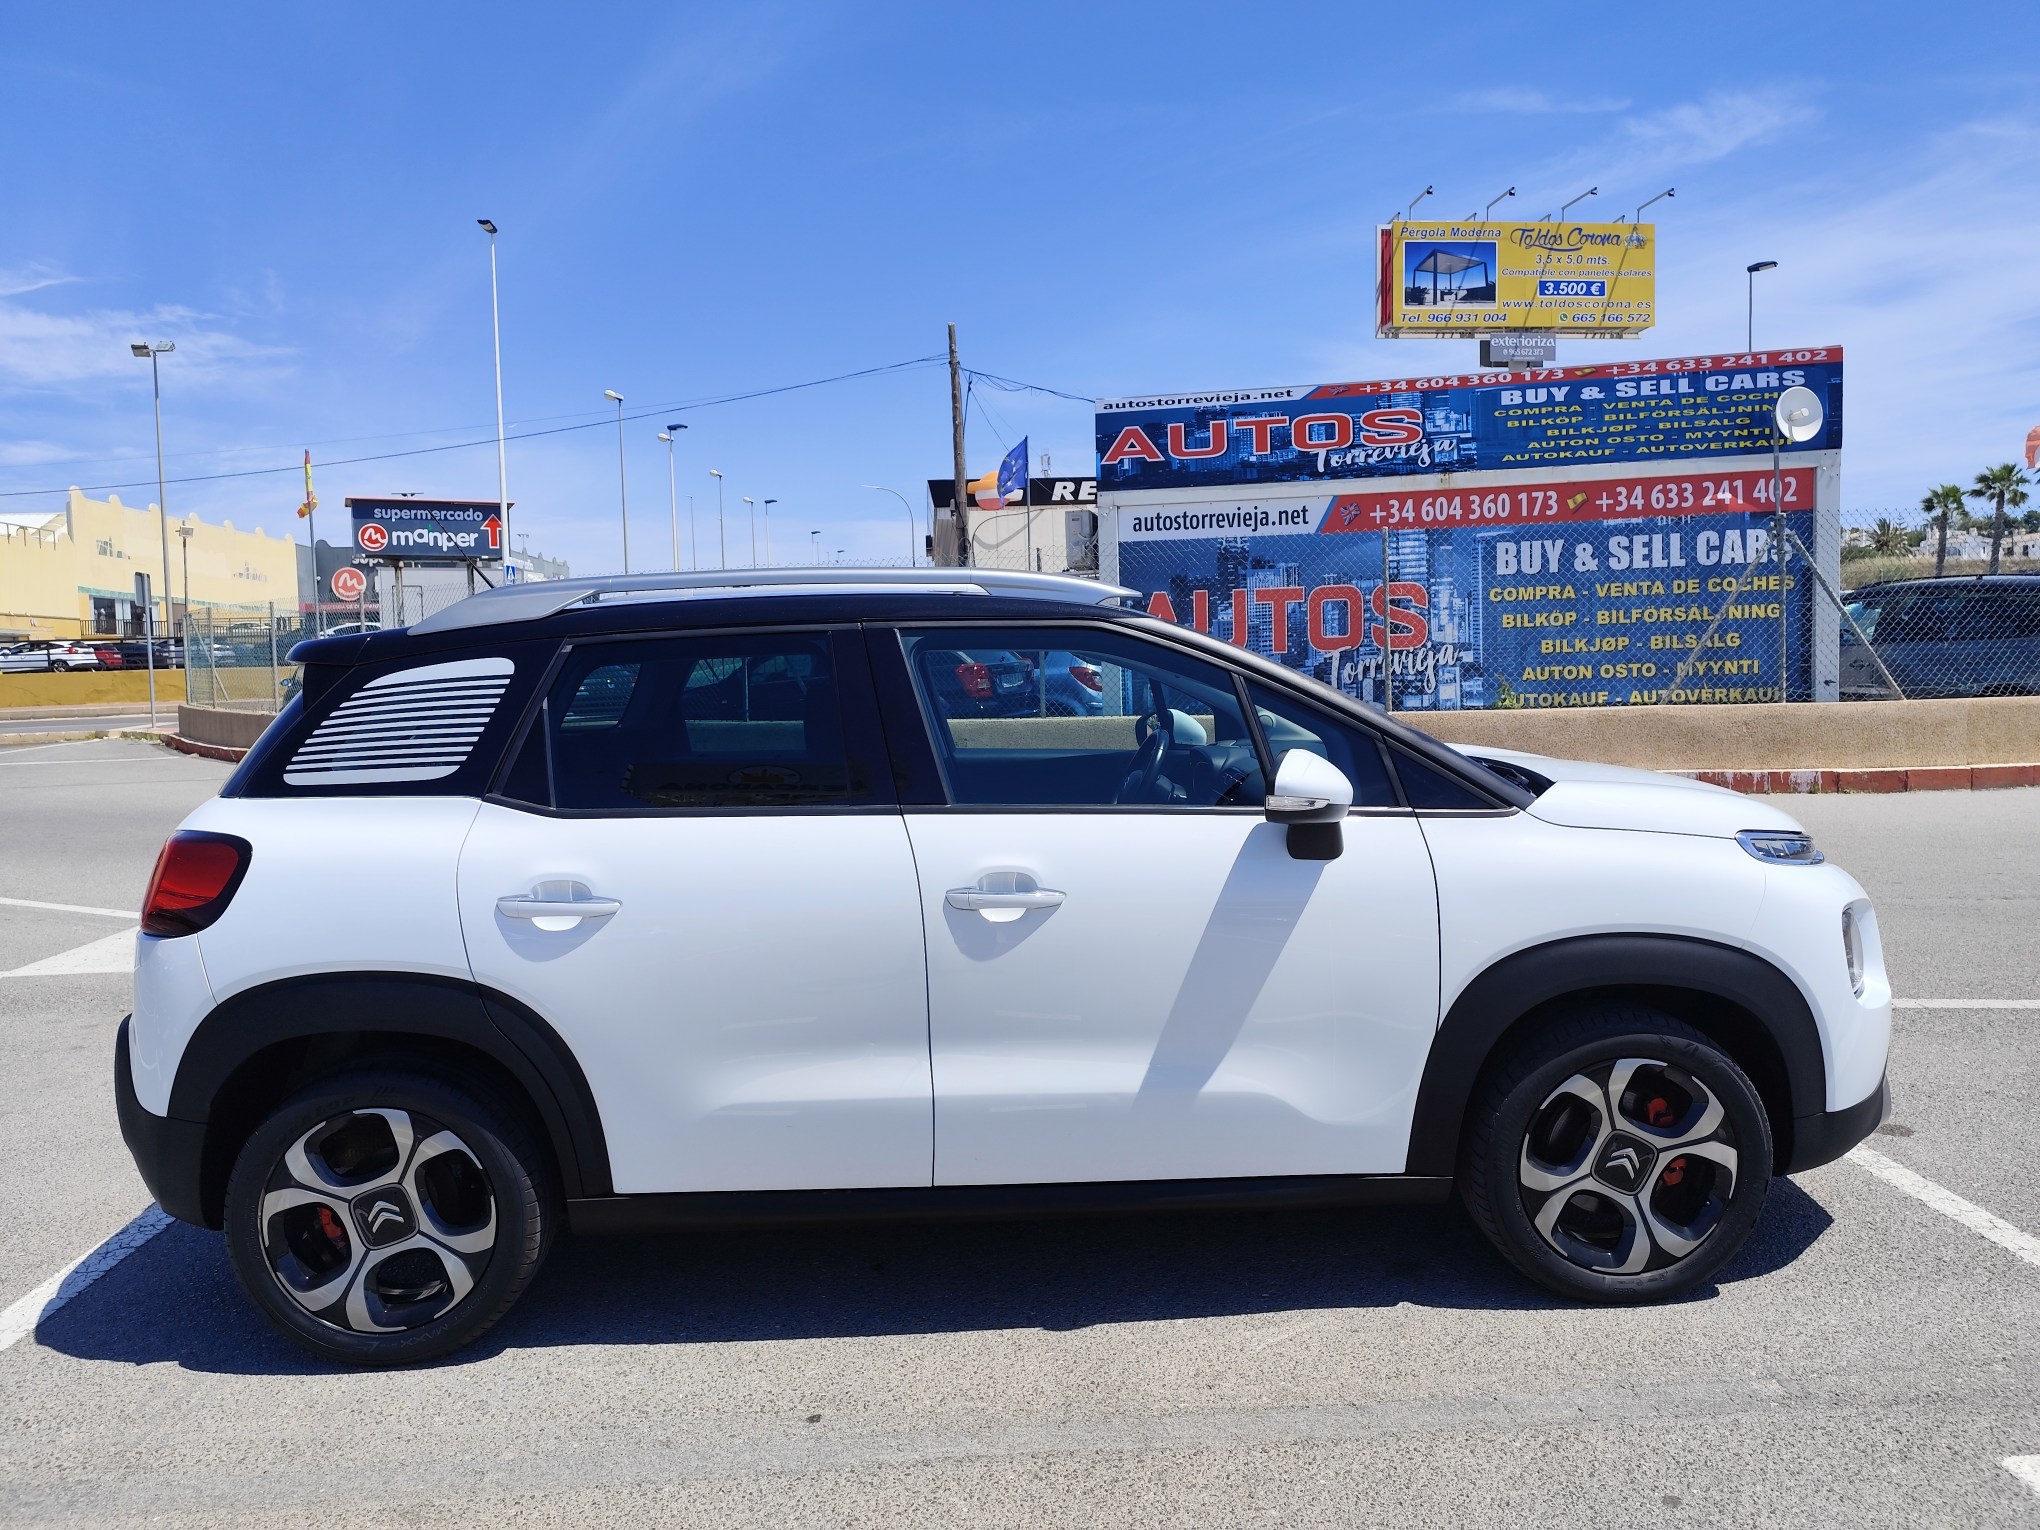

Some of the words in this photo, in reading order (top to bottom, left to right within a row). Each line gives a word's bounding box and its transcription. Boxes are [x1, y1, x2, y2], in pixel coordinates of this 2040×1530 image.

[1400, 226, 1446, 240] Pérgola
[1450, 227, 1502, 238] Moderna
[1510, 227, 1564, 250] Toldos
[1567, 227, 1621, 247] Corona
[1586, 254, 1610, 265] mts.
[1502, 268, 1556, 278] Compatible
[1579, 268, 1616, 278] paneles
[1618, 269, 1652, 277] solares
[1544, 282, 1586, 295] 3.500
[1590, 282, 1602, 295] €
[1502, 298, 1651, 309] www.toldoscorona.es
[1400, 313, 1423, 323] Tel.
[1427, 313, 1452, 323] 966
[1455, 313, 1478, 323] 931
[1483, 313, 1507, 323] 004
[1572, 313, 1596, 323] 665
[1600, 313, 1623, 323] 166
[1627, 313, 1651, 323] 572
[1491, 335, 1555, 347] exterioriza
[1606, 363, 1658, 375] +34
[1666, 358, 1713, 370] 633
[1721, 353, 1768, 367] 241
[1778, 350, 1828, 363] 402
[1360, 381, 1408, 393] +34
[1415, 376, 1460, 389] 604
[1467, 372, 1512, 385] 360
[1521, 368, 1565, 381] 173
[1500, 386, 1570, 405] BUY
[1580, 386, 1606, 400] &
[1615, 377, 1694, 398] SELL
[1705, 370, 1805, 392] CARS
[1103, 388, 1293, 410] autostorrevieja.net
[1493, 404, 1582, 417] COMPRA
[1603, 399, 1673, 410] VENTA
[1681, 396, 1708, 405] DE
[1717, 391, 1779, 402] COCH
[1506, 416, 1584, 428] BILKÖP
[1604, 404, 1774, 421] BILFÖRSÄLJNIN
[1101, 408, 1424, 465] AUTOS
[1546, 424, 1637, 437] BILKJØP
[1658, 417, 1751, 430] BILSALG
[1527, 437, 1599, 449] AUTON
[1607, 434, 1664, 444] OSTO
[1686, 428, 1771, 440] MYYNTI
[1307, 437, 1455, 473] Torrevieja
[1502, 448, 1616, 462] AUTOKAUF
[1051, 481, 1098, 501] RE
[1596, 486, 1644, 512] +34
[1650, 481, 1694, 509] 633
[1702, 478, 1744, 506] 241
[1753, 476, 1798, 503] 402
[373, 506, 483, 522] supermercado
[1370, 499, 1415, 524] +34
[1421, 496, 1462, 522] 604
[1469, 493, 1511, 519] 360
[1518, 490, 1559, 517] 173
[1132, 507, 1309, 533] autostorrevieja.net
[391, 527, 479, 551] manper
[1496, 538, 1565, 576] BUY
[1573, 542, 1599, 573] &
[1608, 532, 1687, 570] SELL
[1696, 528, 1793, 566] CARS
[1489, 584, 1576, 602] COMPRA
[1595, 581, 1665, 597] VENTA
[1673, 579, 1700, 594] DE
[1502, 609, 1577, 628] BILKÖP
[1597, 603, 1780, 625] BILFÖRSÄLNING
[1541, 636, 1630, 654] BILKJØP
[1522, 664, 1593, 681] AUTON
[1600, 663, 1656, 679] OSTO
[1512, 691, 1609, 707] UTOKAUF
